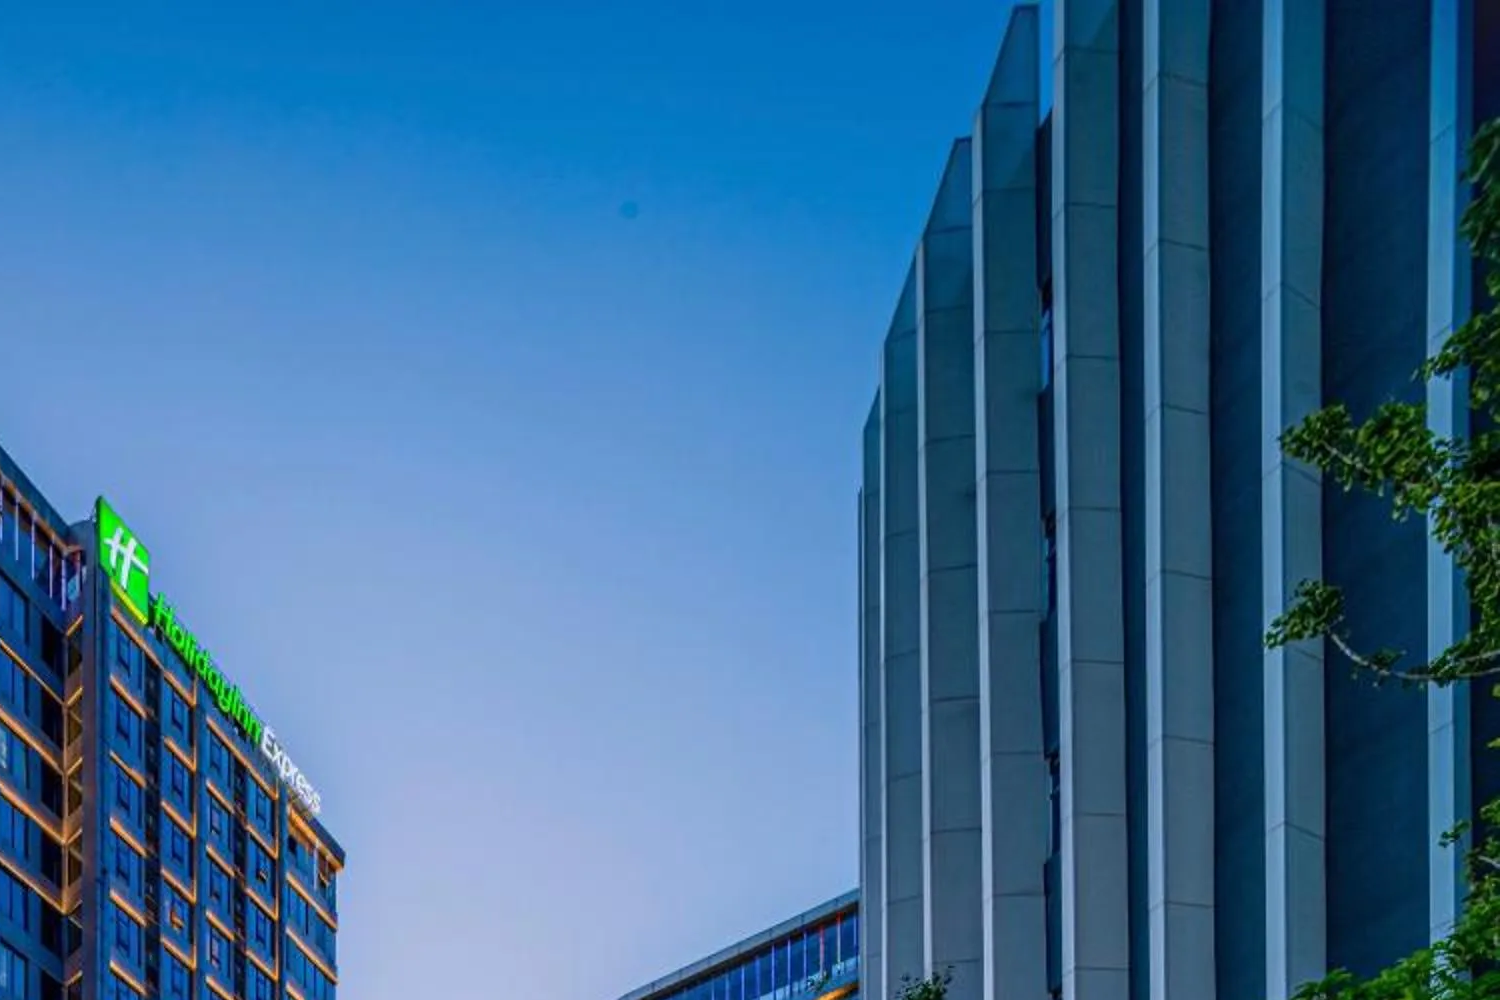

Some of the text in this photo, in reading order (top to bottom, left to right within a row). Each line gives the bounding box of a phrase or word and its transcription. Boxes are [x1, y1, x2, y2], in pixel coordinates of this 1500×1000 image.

[154, 591, 321, 814] Holiday Inn Express
